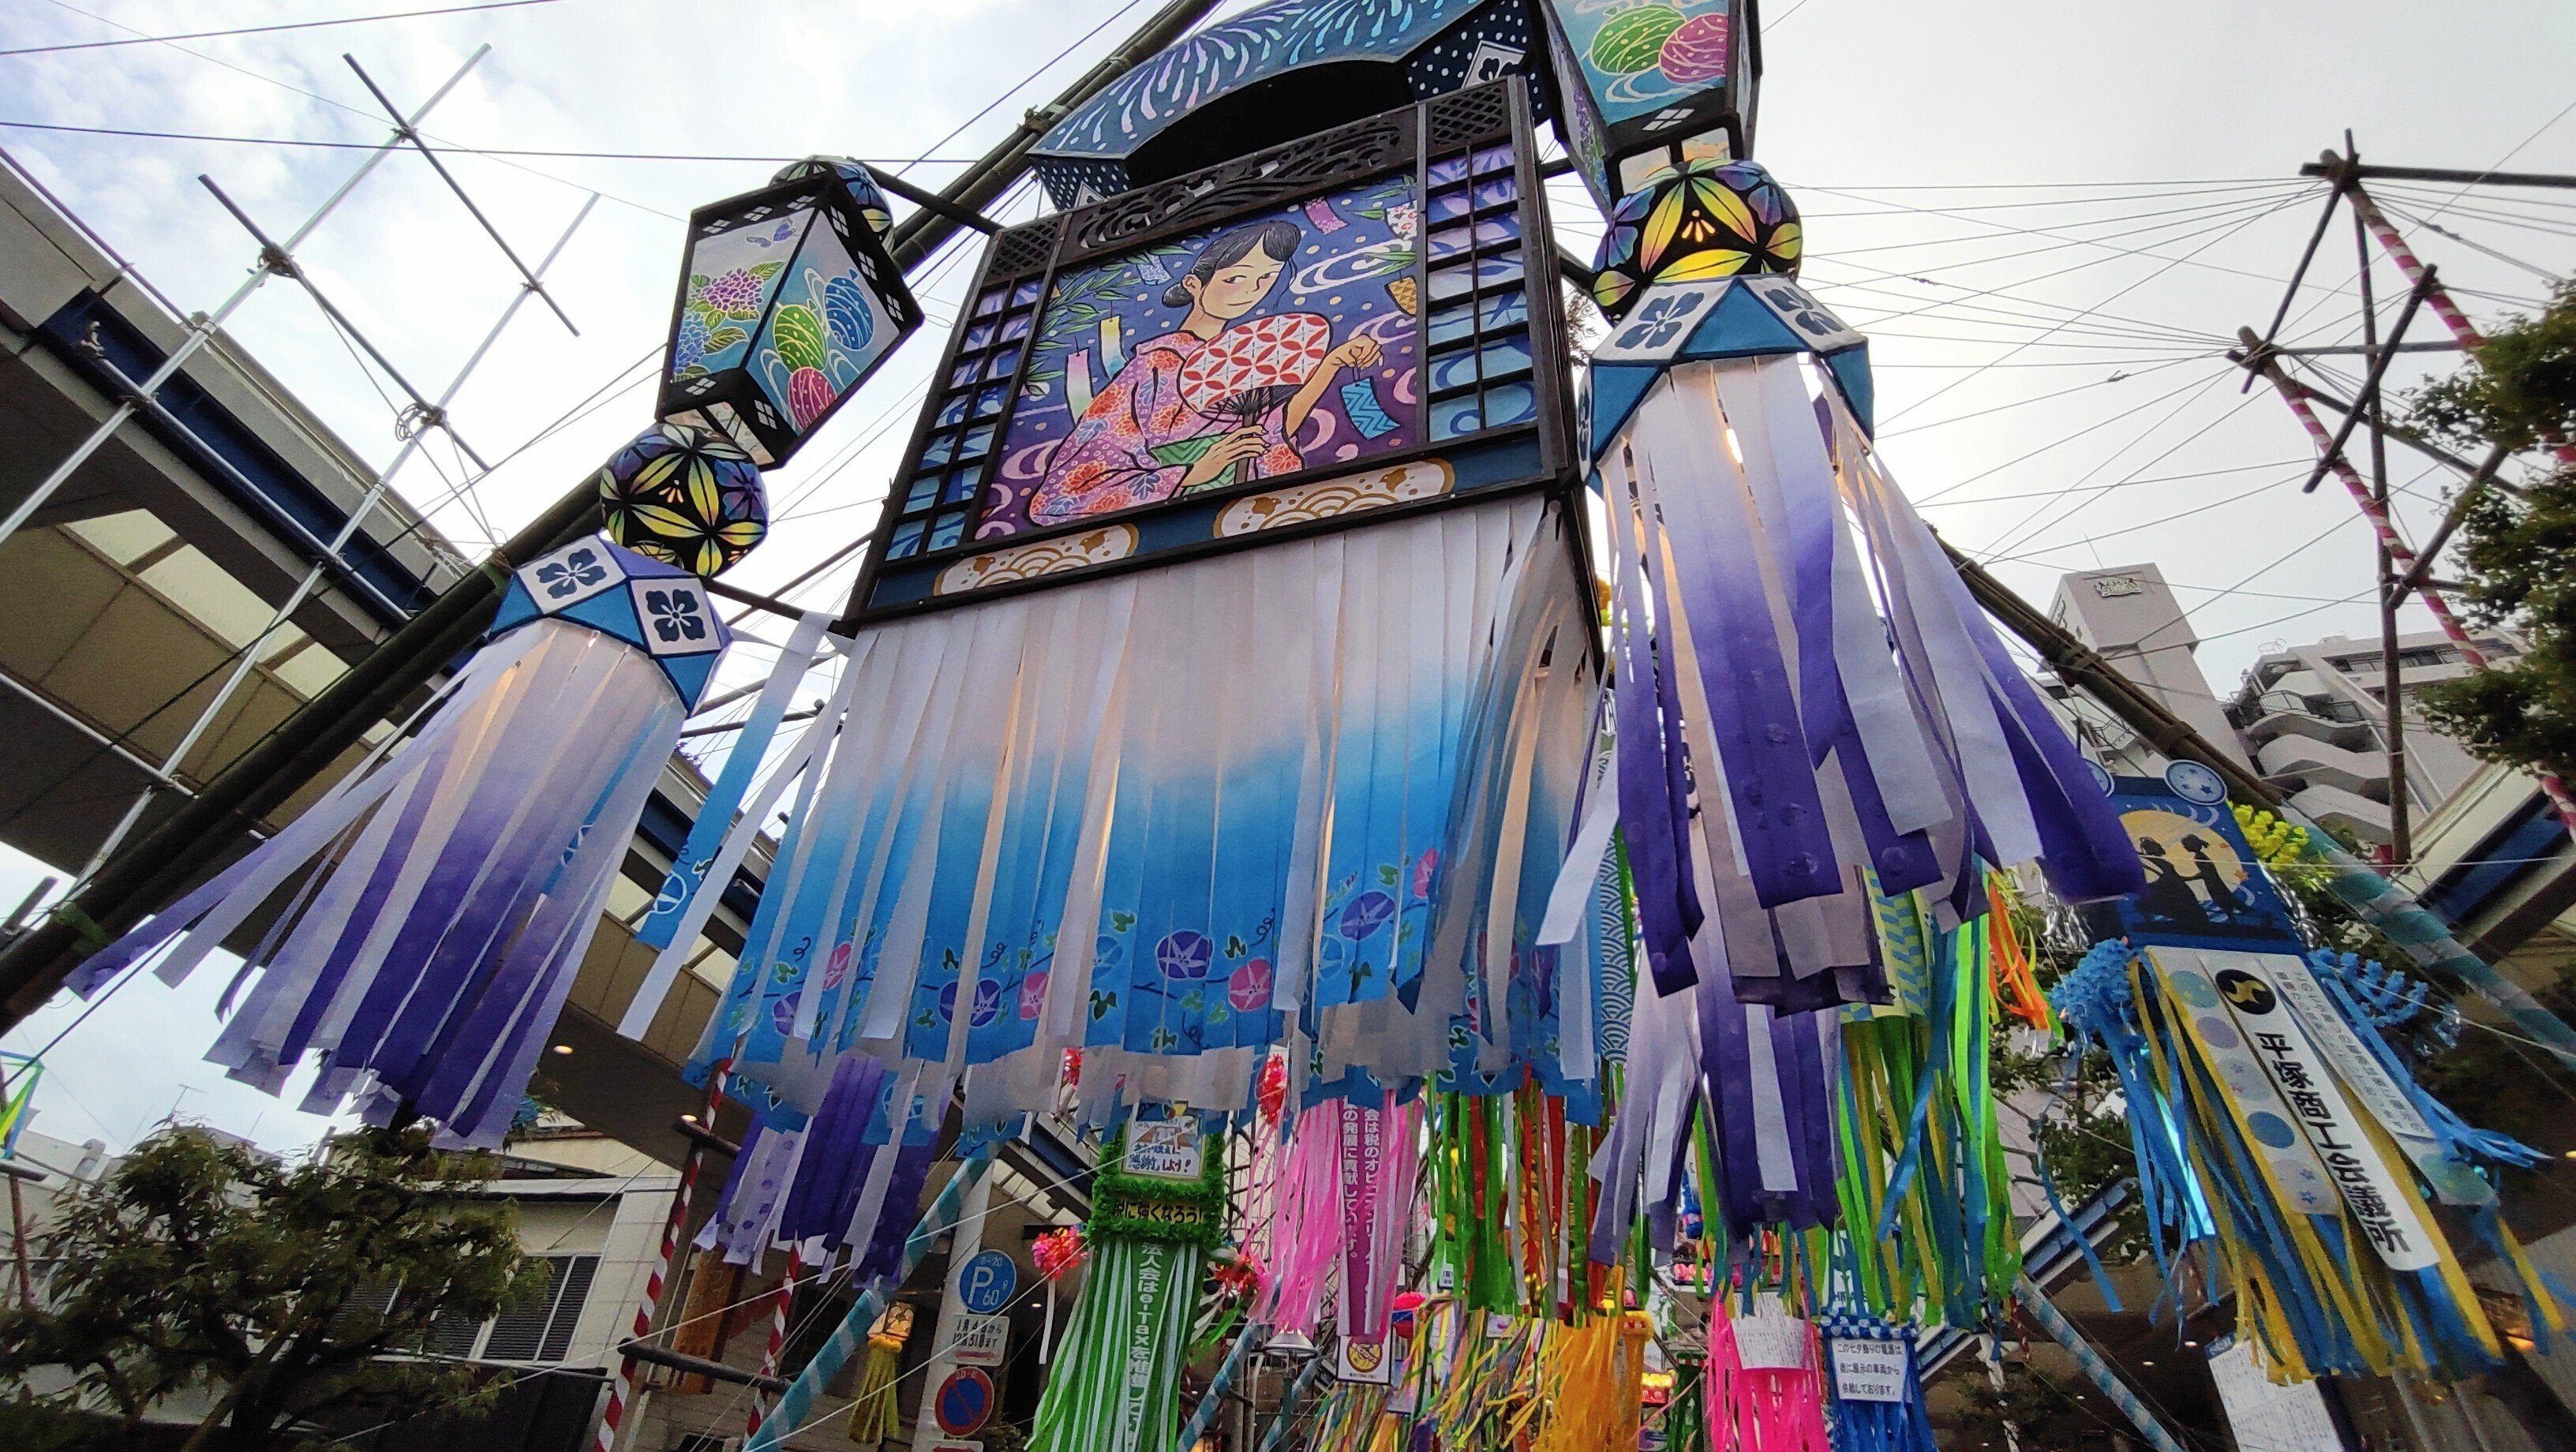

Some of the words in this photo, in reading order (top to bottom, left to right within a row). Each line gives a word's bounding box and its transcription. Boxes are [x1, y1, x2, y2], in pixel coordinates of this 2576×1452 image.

[2255, 1031, 2411, 1253] 平塚商工会議所
[968, 1267, 994, 1304] P
[983, 1289, 999, 1306] 60
